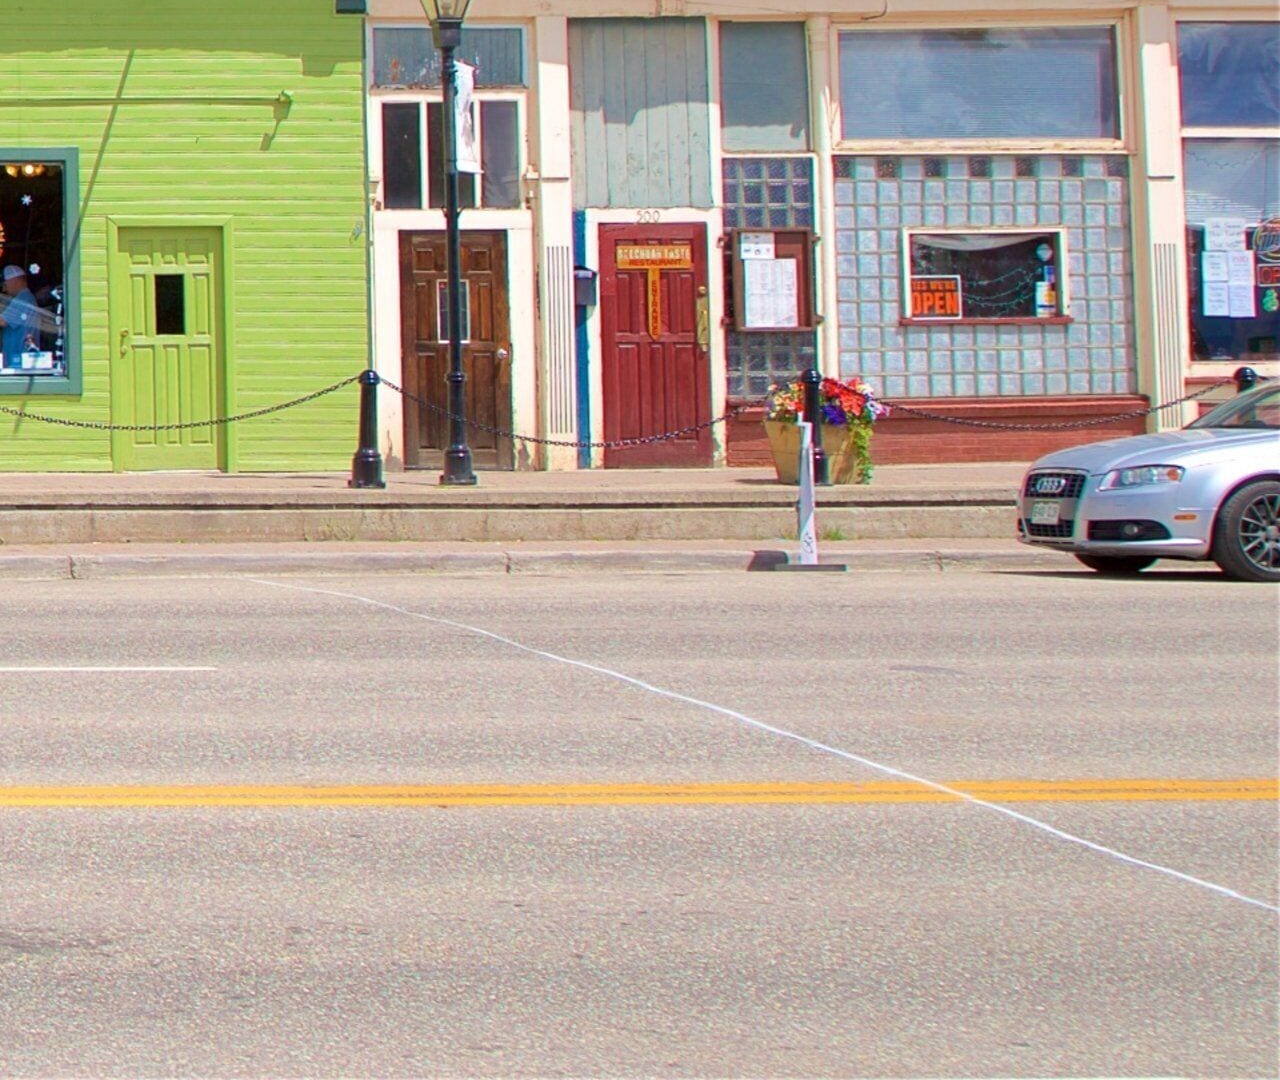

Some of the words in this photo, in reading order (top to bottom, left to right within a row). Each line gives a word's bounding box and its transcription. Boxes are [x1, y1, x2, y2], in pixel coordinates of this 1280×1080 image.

[637, 210, 661, 223] 500
[651, 280, 659, 336] ENTRANCE
[912, 291, 958, 315] OPEN
